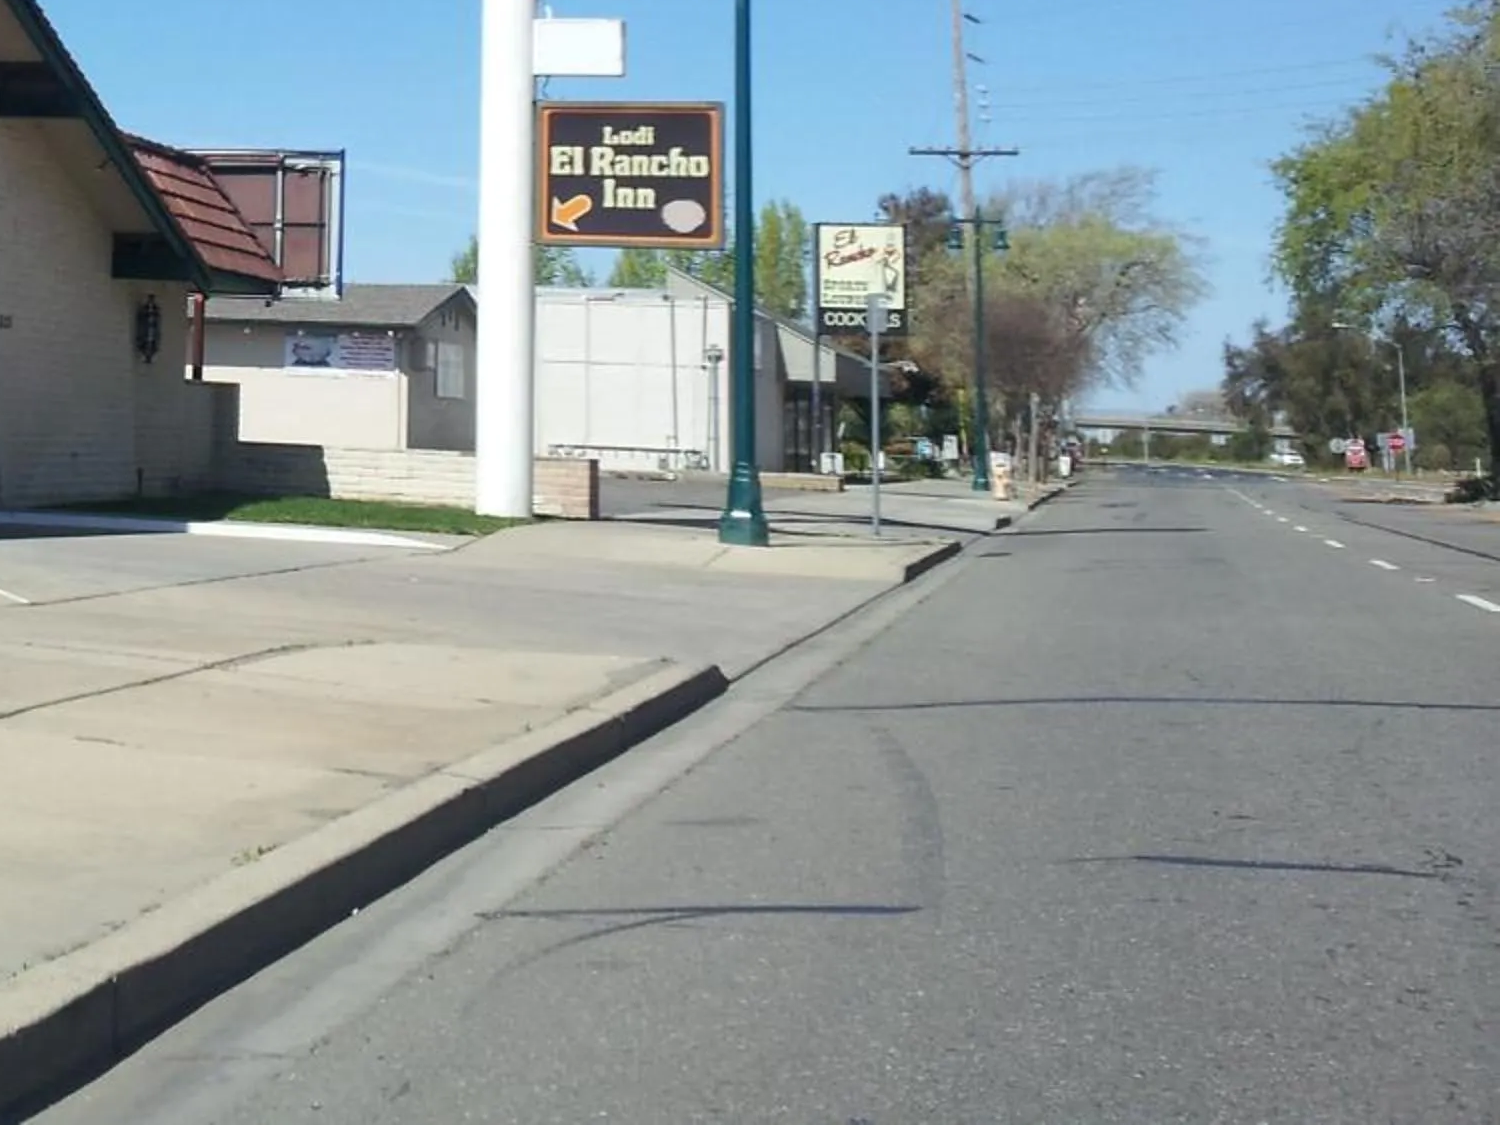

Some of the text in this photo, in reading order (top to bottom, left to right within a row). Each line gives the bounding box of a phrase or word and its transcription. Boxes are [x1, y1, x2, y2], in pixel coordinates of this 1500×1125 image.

[603, 126, 655, 145] Lodi
[550, 146, 709, 176] El Rancho
[603, 178, 656, 208] Inn
